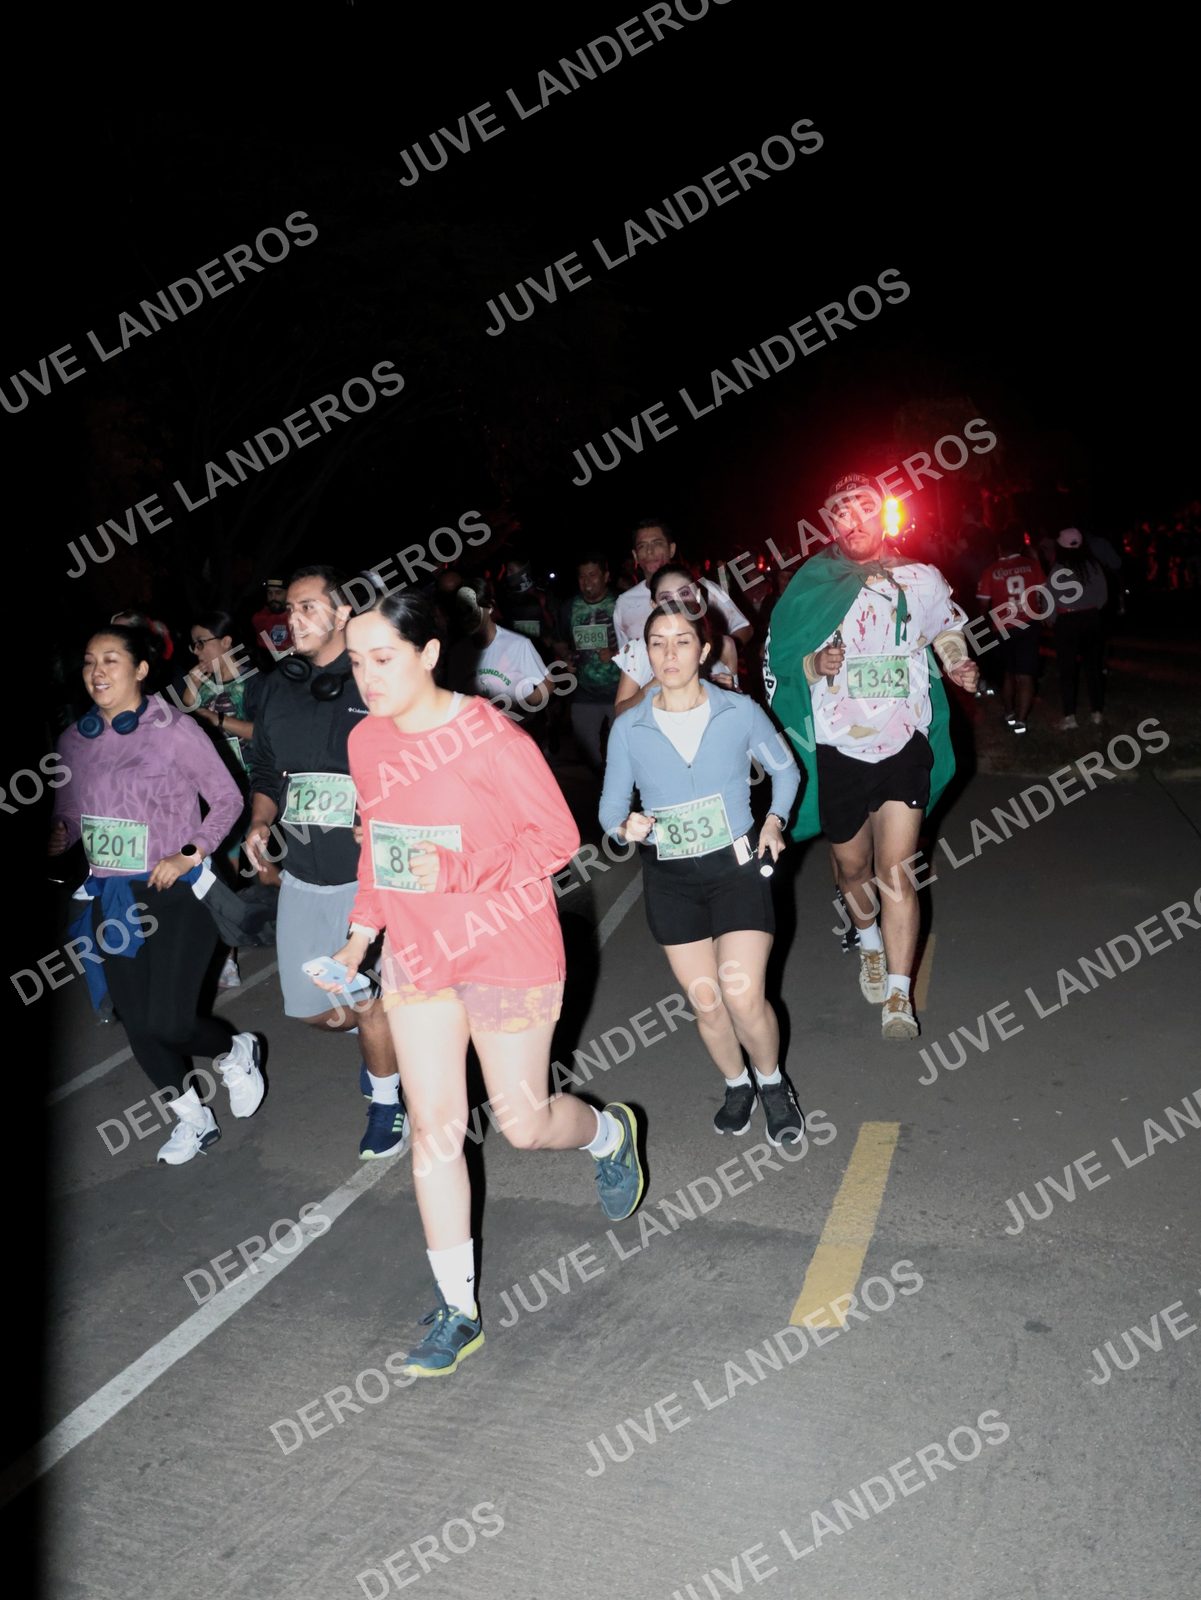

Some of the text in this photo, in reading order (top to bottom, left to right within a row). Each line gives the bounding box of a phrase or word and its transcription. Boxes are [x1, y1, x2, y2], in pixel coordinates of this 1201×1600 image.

[577, 632, 604, 643] 2689
[854, 667, 904, 688] 1342
[293, 789, 348, 813] 1202
[667, 816, 713, 845] 853
[86, 832, 137, 858] 1201
